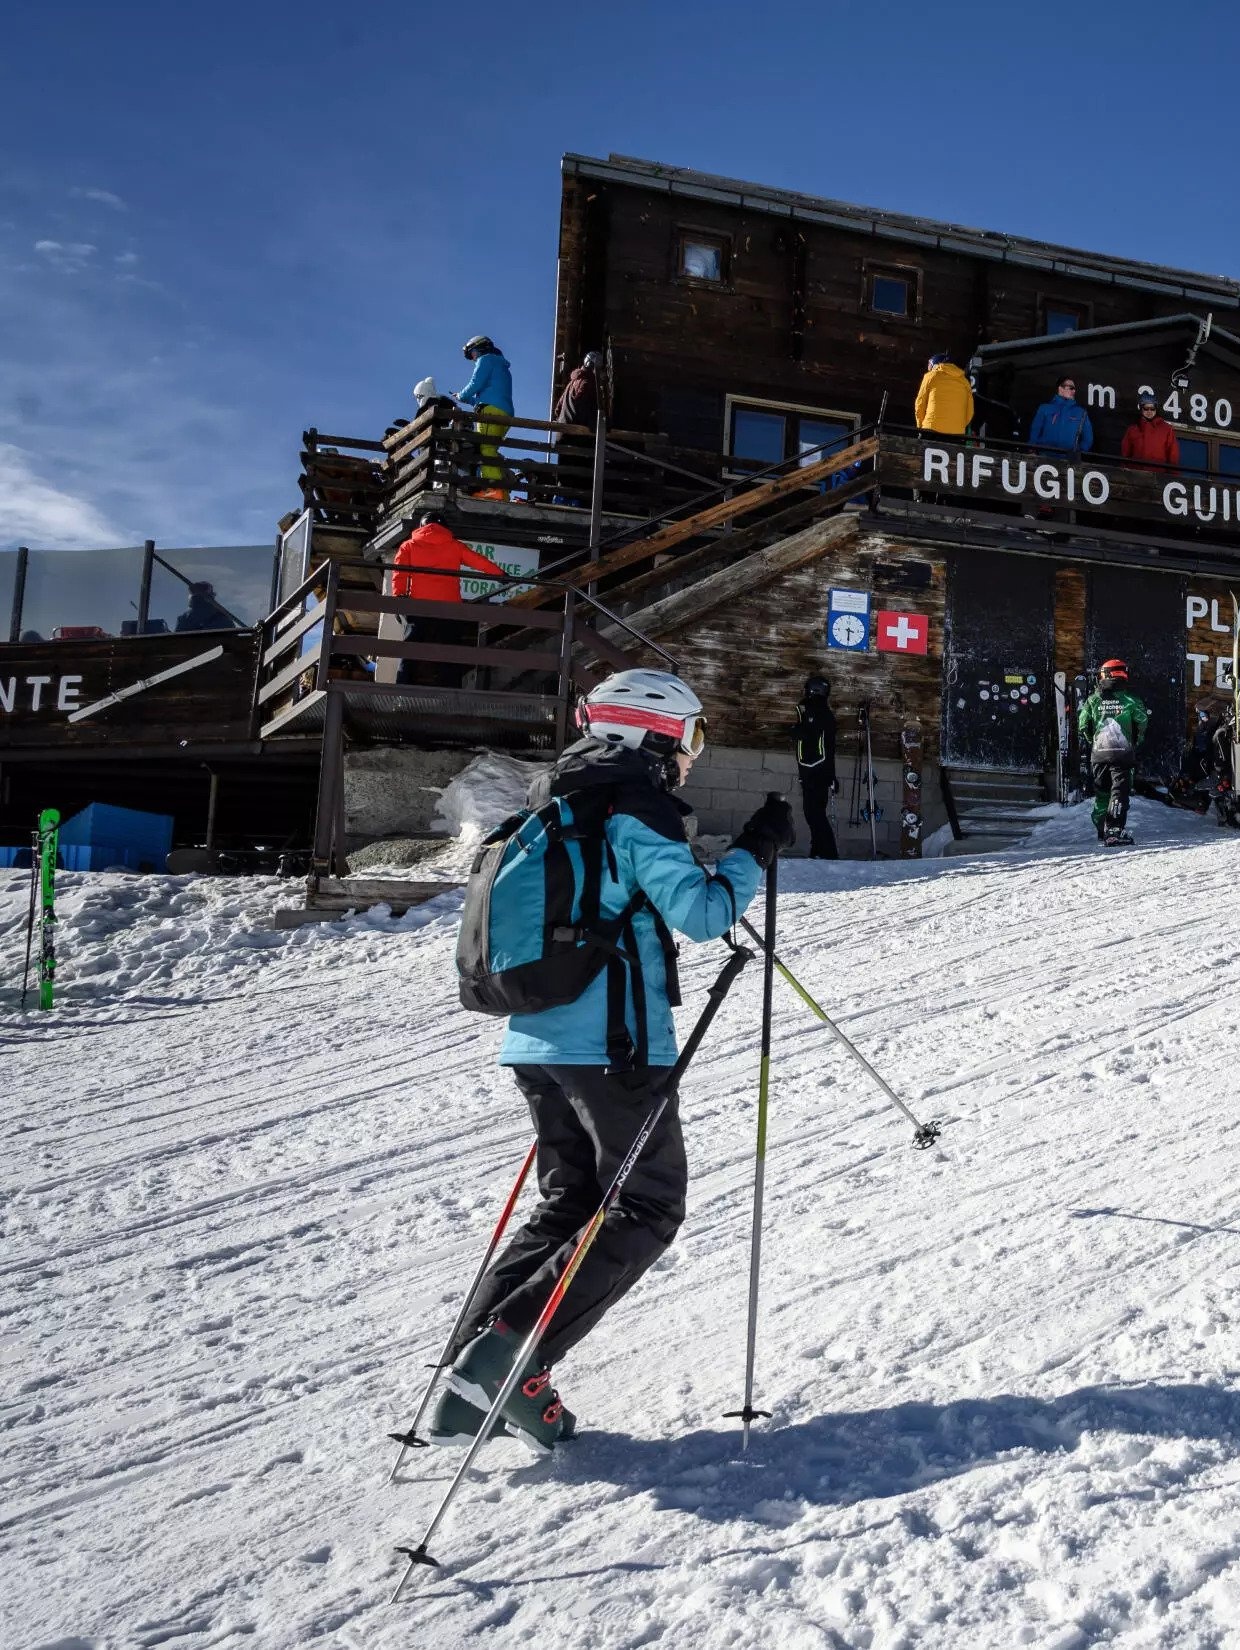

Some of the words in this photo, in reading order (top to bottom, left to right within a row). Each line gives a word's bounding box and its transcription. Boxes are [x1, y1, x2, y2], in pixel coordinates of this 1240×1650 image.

[1087, 382, 1116, 409] m
[923, 447, 1110, 505] RIFUGIO
[616, 1130, 649, 1187] GIPRON
